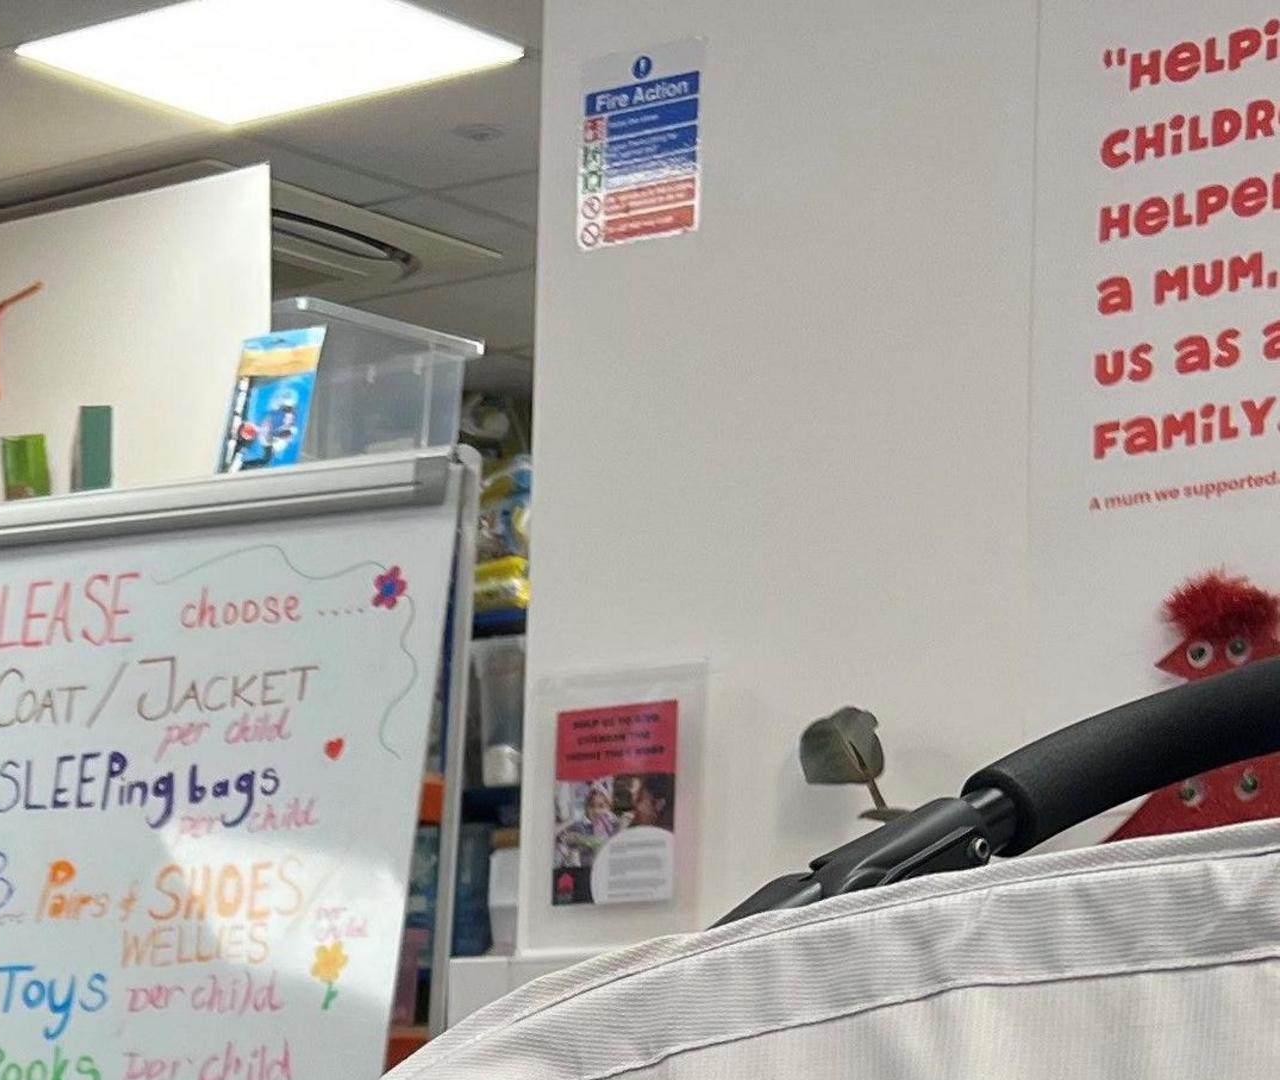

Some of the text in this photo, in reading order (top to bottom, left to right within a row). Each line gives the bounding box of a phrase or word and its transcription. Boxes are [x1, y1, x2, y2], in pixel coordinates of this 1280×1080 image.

[596, 81, 688, 112] Fire Action
[1100, 99, 1280, 169] CHiLDR
[1097, 252, 1278, 315] a MUM.
[1089, 497, 1101, 511] A
[1104, 492, 1151, 509] mum
[1154, 487, 1180, 502] we
[180, 586, 301, 630] choose
[154, 707, 291, 763] per child
[188, 764, 280, 829] bags
[247, 798, 318, 833] child
[121, 922, 270, 968] WELLIES
[122, 984, 185, 1024] per
[190, 970, 285, 1016] child
